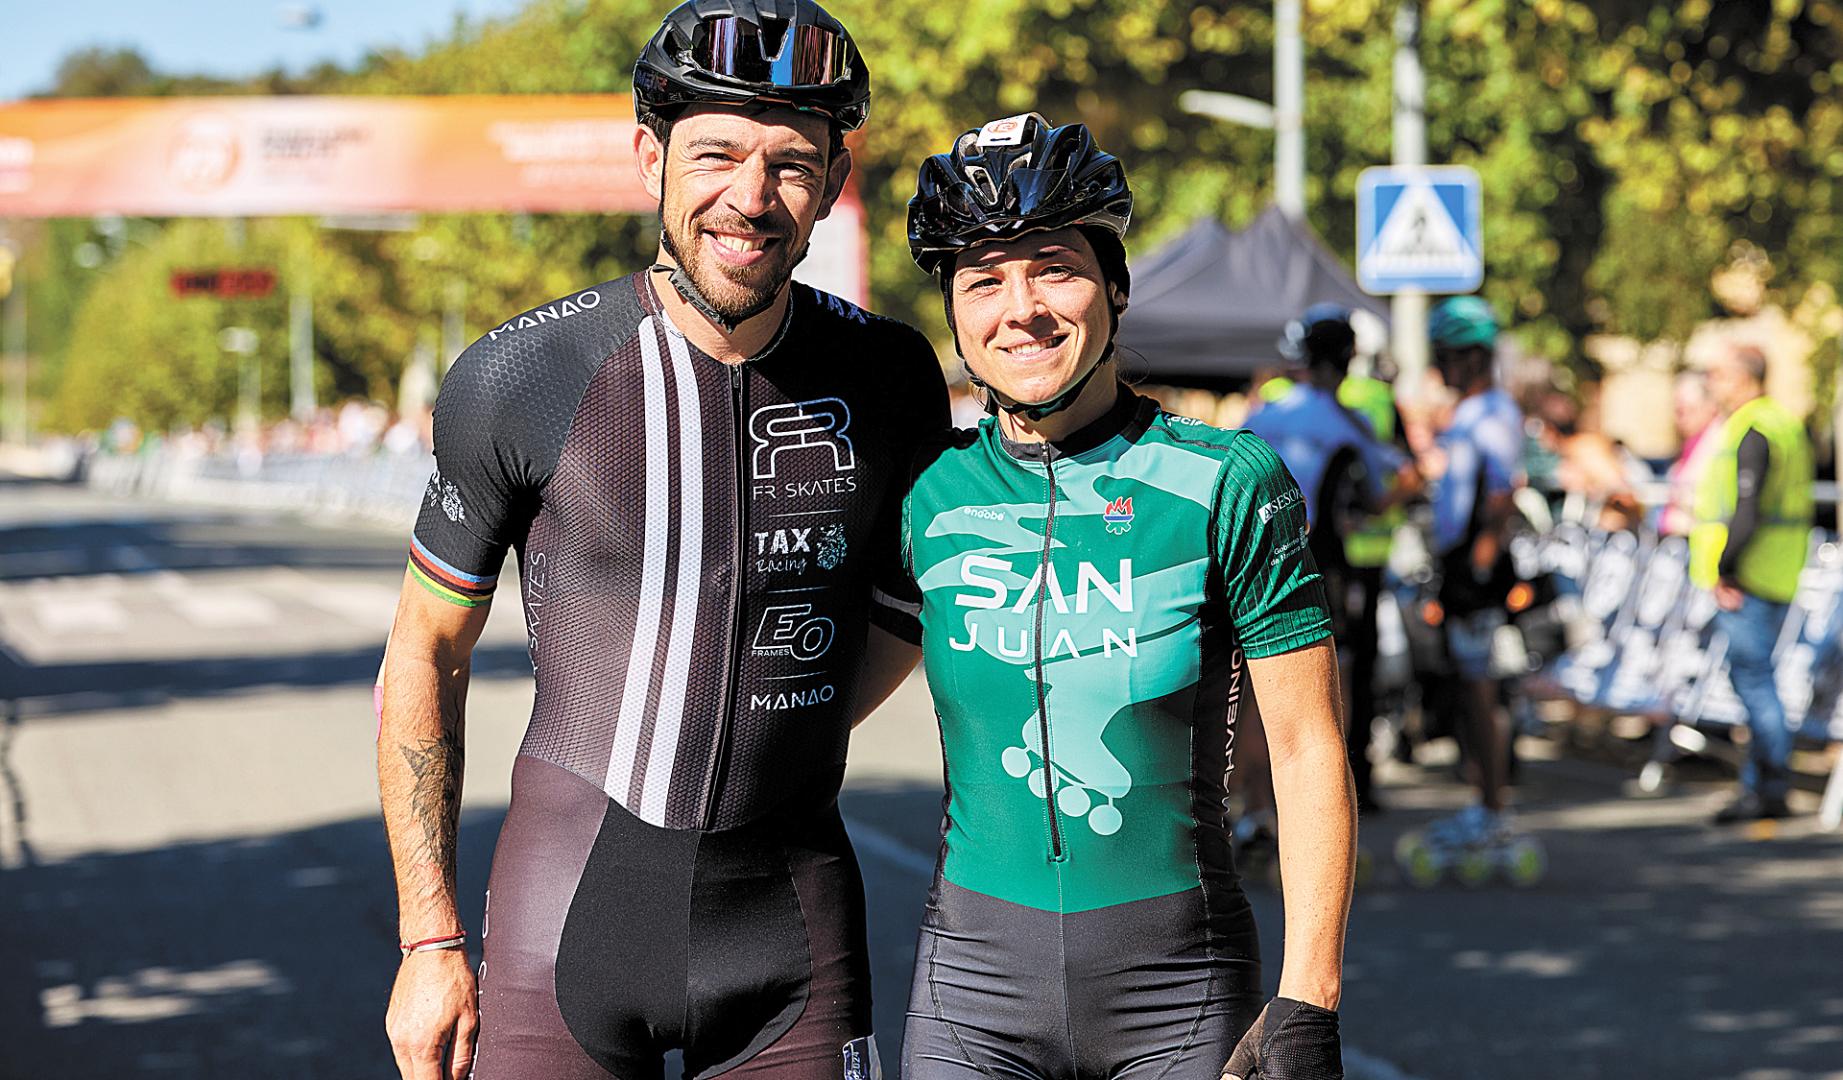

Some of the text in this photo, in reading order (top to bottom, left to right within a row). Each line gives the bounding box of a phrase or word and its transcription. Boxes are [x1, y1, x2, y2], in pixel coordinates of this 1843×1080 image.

[488, 290, 601, 341] MANAO
[753, 477, 857, 501] FR SKATES
[754, 527, 812, 556] TAX
[755, 555, 808, 576] Racing
[955, 554, 1134, 614] SAN
[527, 551, 547, 651] SKATES
[751, 648, 791, 658] FRAMES
[949, 622, 1139, 659] JUAN
[750, 684, 835, 711] MANAO
